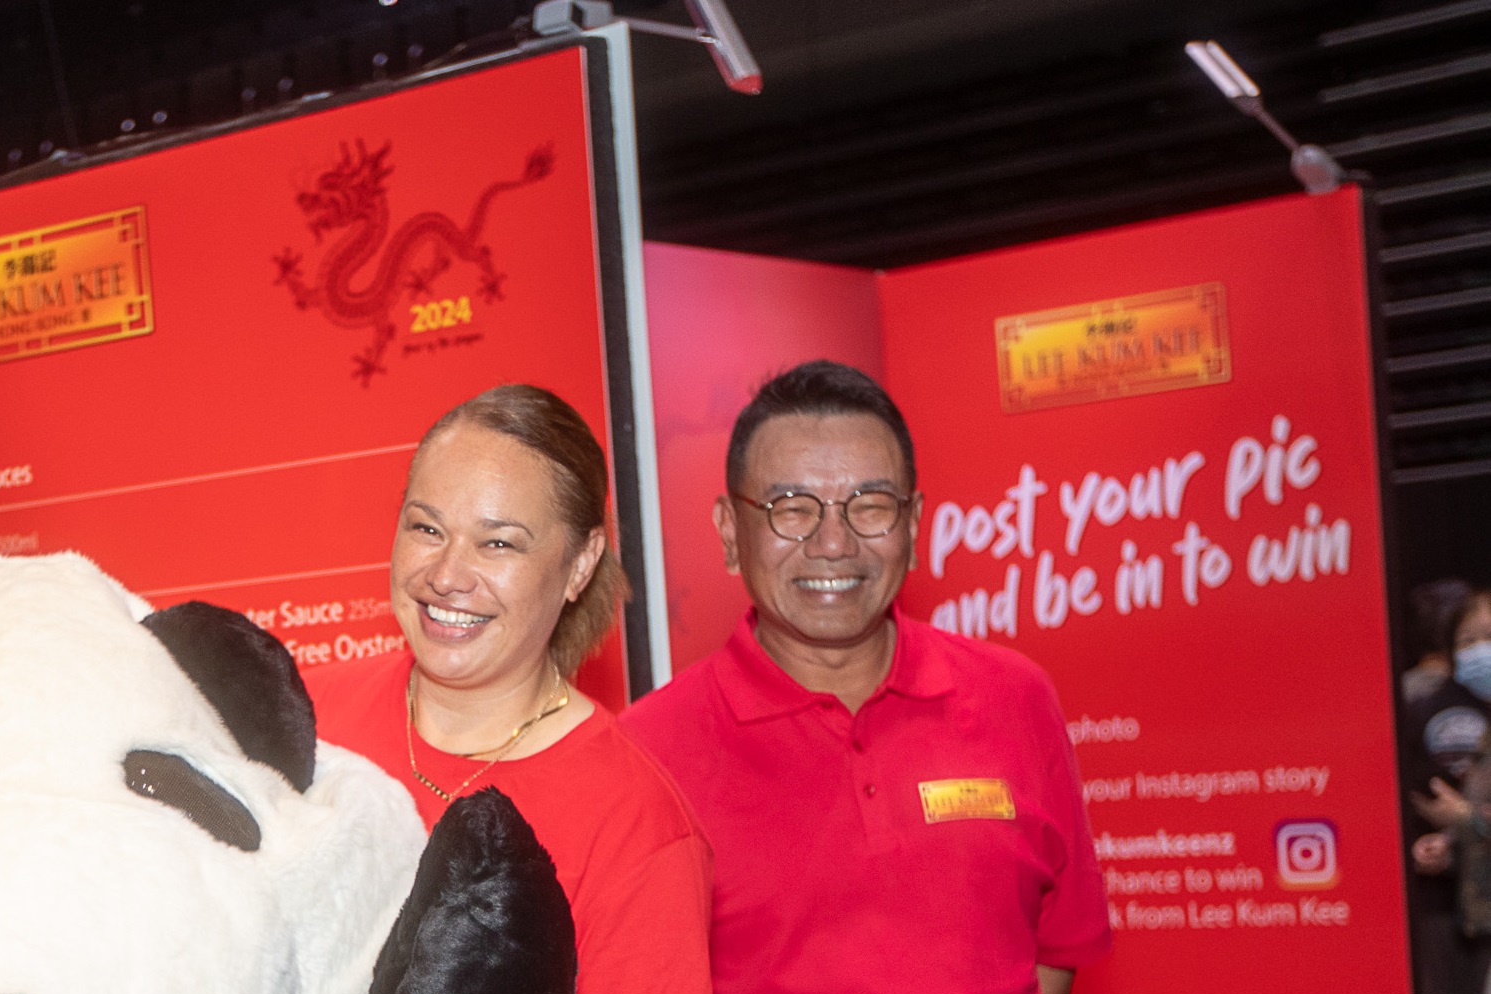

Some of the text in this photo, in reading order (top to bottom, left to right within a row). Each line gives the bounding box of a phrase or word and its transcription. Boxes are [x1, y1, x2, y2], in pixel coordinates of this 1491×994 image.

[73, 261, 126, 302] KEE
[410, 296, 473, 333] 2024
[930, 413, 1321, 579] post your pic
[931, 503, 1351, 638] and be in to win
[279, 601, 344, 628] Sauce
[286, 634, 406, 664] Free Oyster
[1066, 714, 1140, 745] photo
[1135, 770, 1259, 803] Instagram
[1262, 764, 1330, 797] story
[1102, 862, 1263, 894] hance to win
[1126, 899, 1185, 929] from
[1188, 899, 1234, 929] Lee
[1236, 898, 1296, 926] Kum
[1299, 895, 1350, 926] Kee
